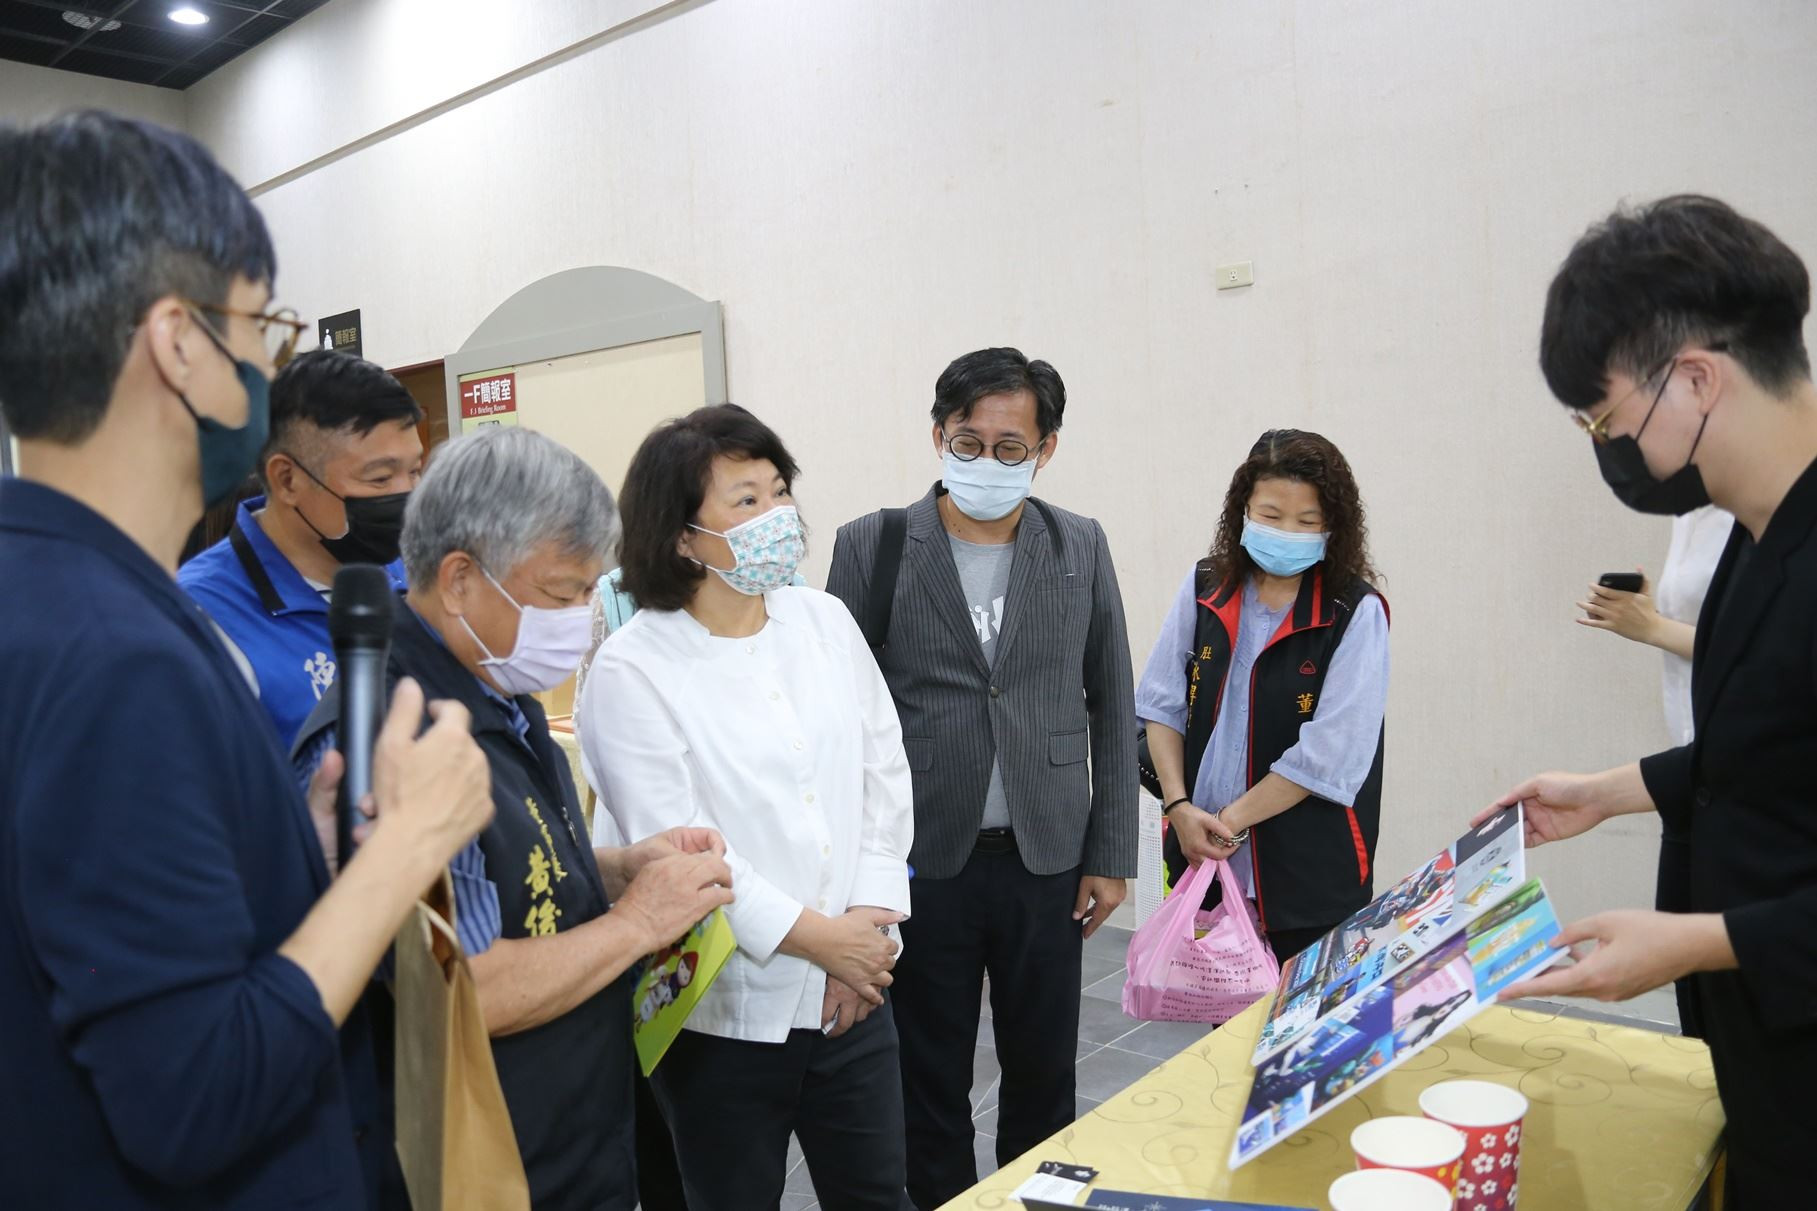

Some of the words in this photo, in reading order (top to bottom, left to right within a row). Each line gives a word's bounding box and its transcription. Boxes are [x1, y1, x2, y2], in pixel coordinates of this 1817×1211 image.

[464, 378, 511, 404] 一F簡報室
[1296, 692, 1314, 714] 董
